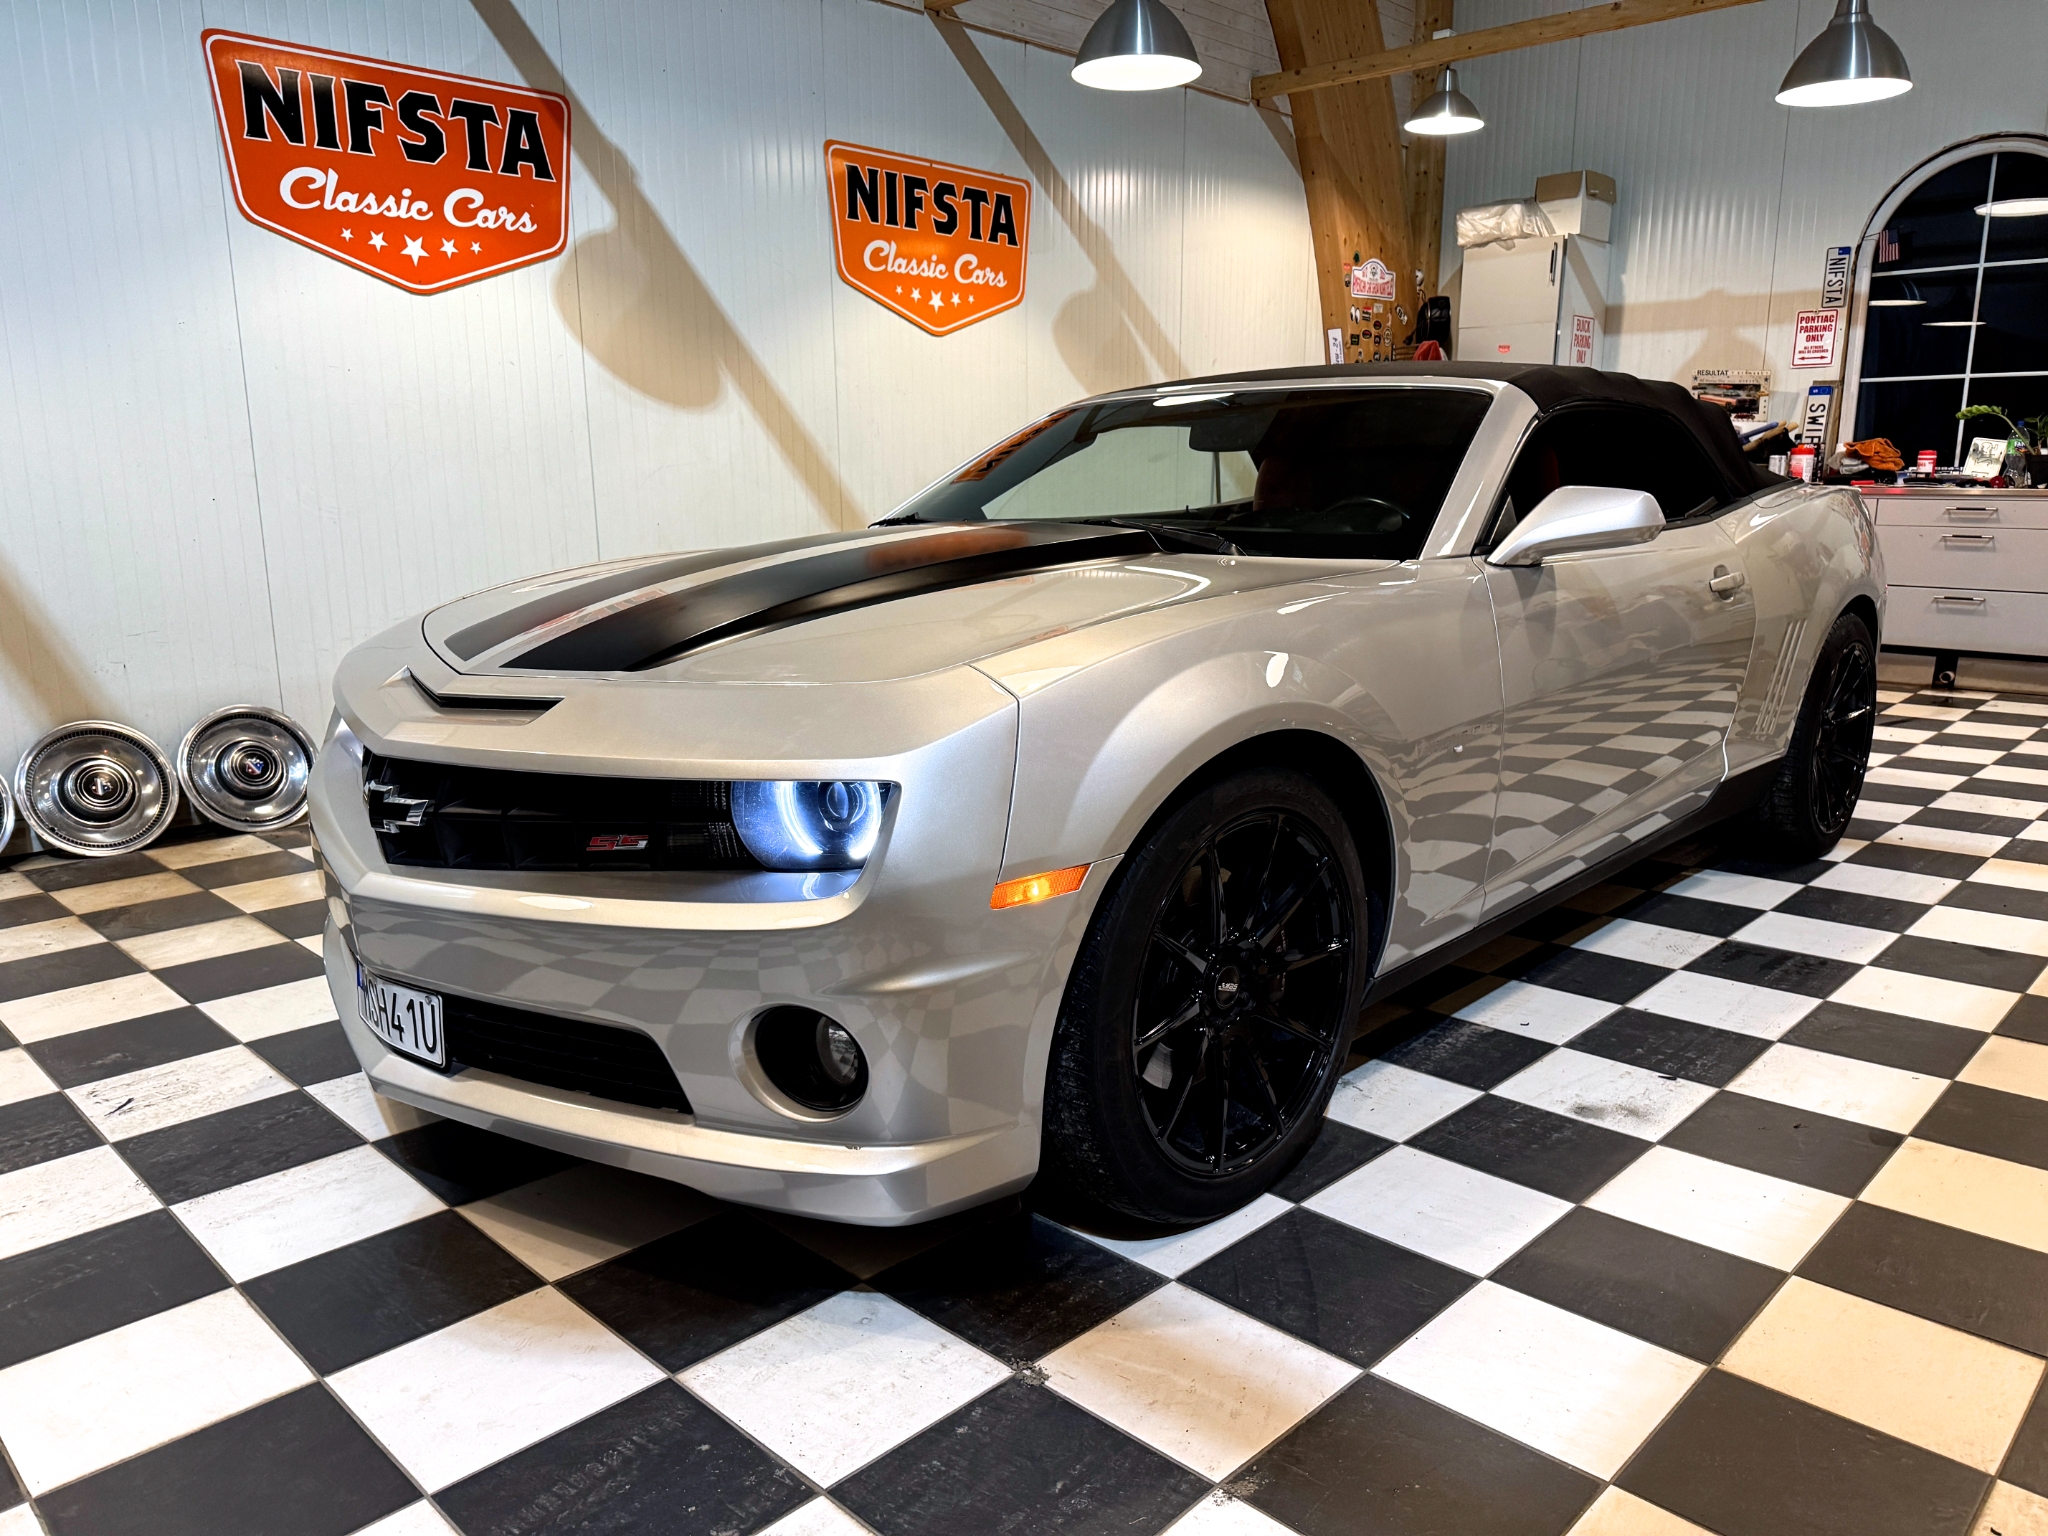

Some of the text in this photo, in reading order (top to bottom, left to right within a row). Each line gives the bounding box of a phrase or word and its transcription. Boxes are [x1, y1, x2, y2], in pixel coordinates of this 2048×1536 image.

[235, 59, 557, 183] NIFSTA
[279, 166, 537, 234] Classic Cars
[844, 162, 1020, 248] NIFSTA
[863, 239, 1007, 288] Classic Cars
[1825, 257, 1846, 304] NIFSTA
[1576, 318, 1591, 333] BUICK
[1800, 314, 1834, 324] PONTIAC
[1799, 324, 1832, 334] PARKING
[1573, 333, 1591, 349] PARKING
[1806, 334, 1824, 342] ONLY
[1576, 349, 1586, 364] ONLY
[586, 834, 649, 852] SS
